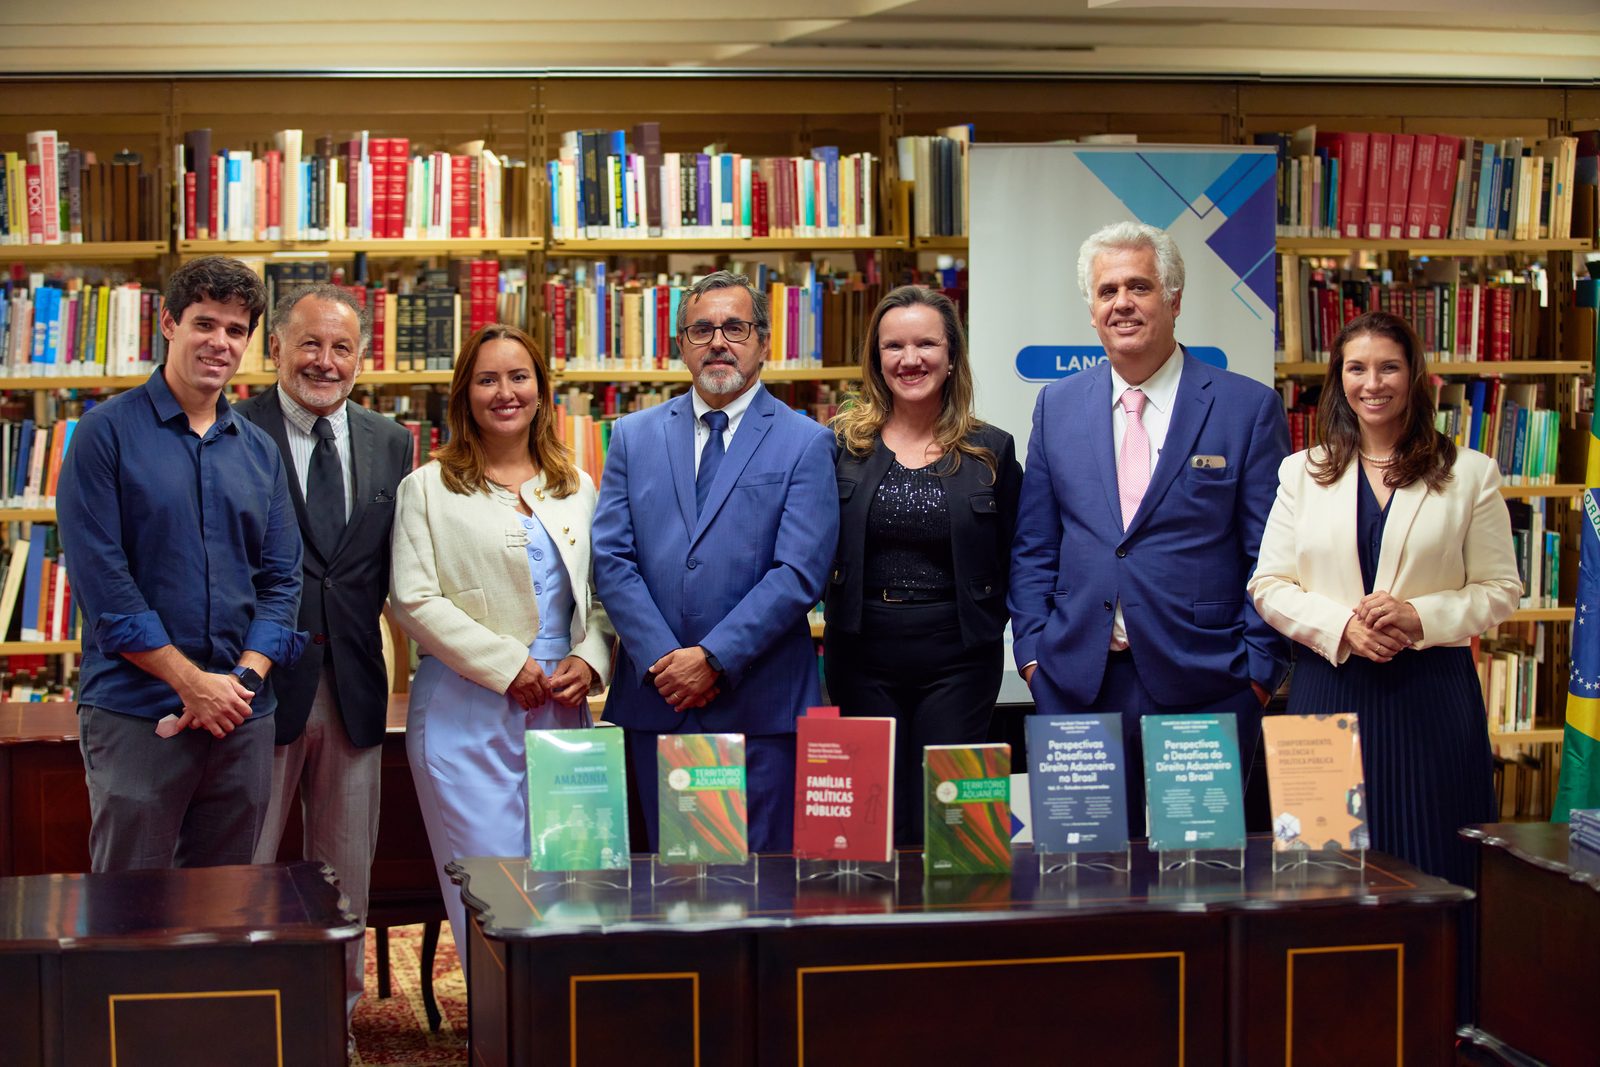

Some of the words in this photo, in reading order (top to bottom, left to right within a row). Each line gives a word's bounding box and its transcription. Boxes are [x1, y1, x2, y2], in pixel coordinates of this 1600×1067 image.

[28, 177, 42, 216] BOOK
[1048, 739, 1104, 751] Perspectivas
[1164, 739, 1220, 751] Perspectivas
[1054, 750, 1093, 761] Desafios
[1094, 750, 1107, 760] do
[1163, 753, 1170, 761] e
[1170, 750, 1209, 761] Desafios
[1210, 749, 1223, 760] do
[695, 767, 741, 777] TERRITÓRIO
[1039, 762, 1069, 772] Direito
[1069, 761, 1116, 772] Aduaneiro
[1156, 762, 1186, 772] Direito
[1186, 760, 1232, 771] Aduaneiro
[554, 772, 608, 785] AMAZÔNIA
[695, 777, 741, 787] ADUANEIRO
[807, 774, 845, 789] FAMÍLIA
[846, 777, 852, 789] E
[1059, 775, 1071, 783] no
[1072, 772, 1098, 783] Brasil
[1175, 774, 1188, 782] no
[1188, 771, 1214, 782] Brasil
[962, 780, 1006, 790] TERRITÓRIO
[806, 789, 854, 803] POLÍTICAS
[962, 790, 1006, 798] ADUANEIRO
[806, 803, 852, 818] PÚBLICAS
